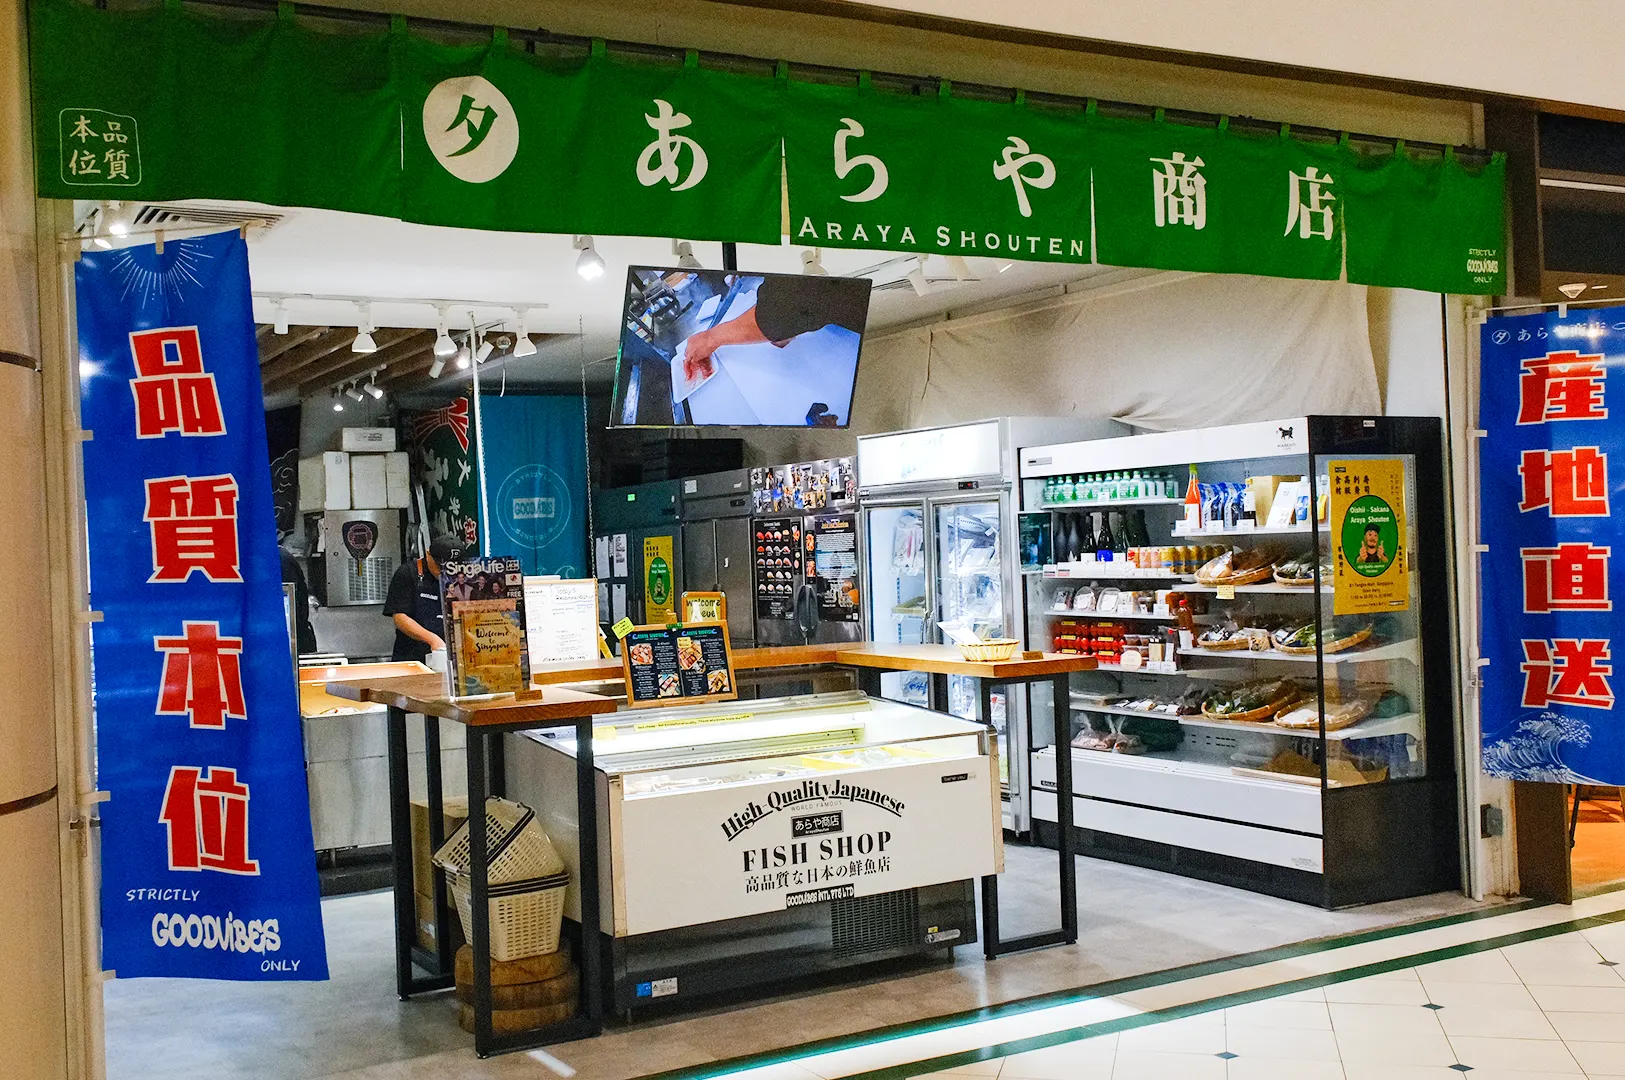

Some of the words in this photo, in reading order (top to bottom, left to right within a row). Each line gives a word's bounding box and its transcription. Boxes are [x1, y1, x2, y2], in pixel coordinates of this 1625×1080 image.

[936, 226, 1085, 257] SHOUTEN
[1350, 506, 1366, 514] Oishii
[1370, 505, 1390, 513] Sakana
[1515, 350, 1615, 711] 産地直送
[446, 560, 505, 578] SingaLife
[129, 325, 261, 876] 品質本位
[507, 590, 522, 598] FREE
[475, 628, 509, 639] Welcome
[475, 642, 510, 653] Singapore
[831, 779, 906, 814] Japanese
[795, 814, 840, 832] あらや商店
[743, 842, 808, 872] FISH
[819, 831, 892, 861] SHOP
[745, 856, 891, 894] 高品質な日本の鮮魚店
[126, 888, 200, 902] STRICTLY
[260, 959, 301, 972] ONLY
